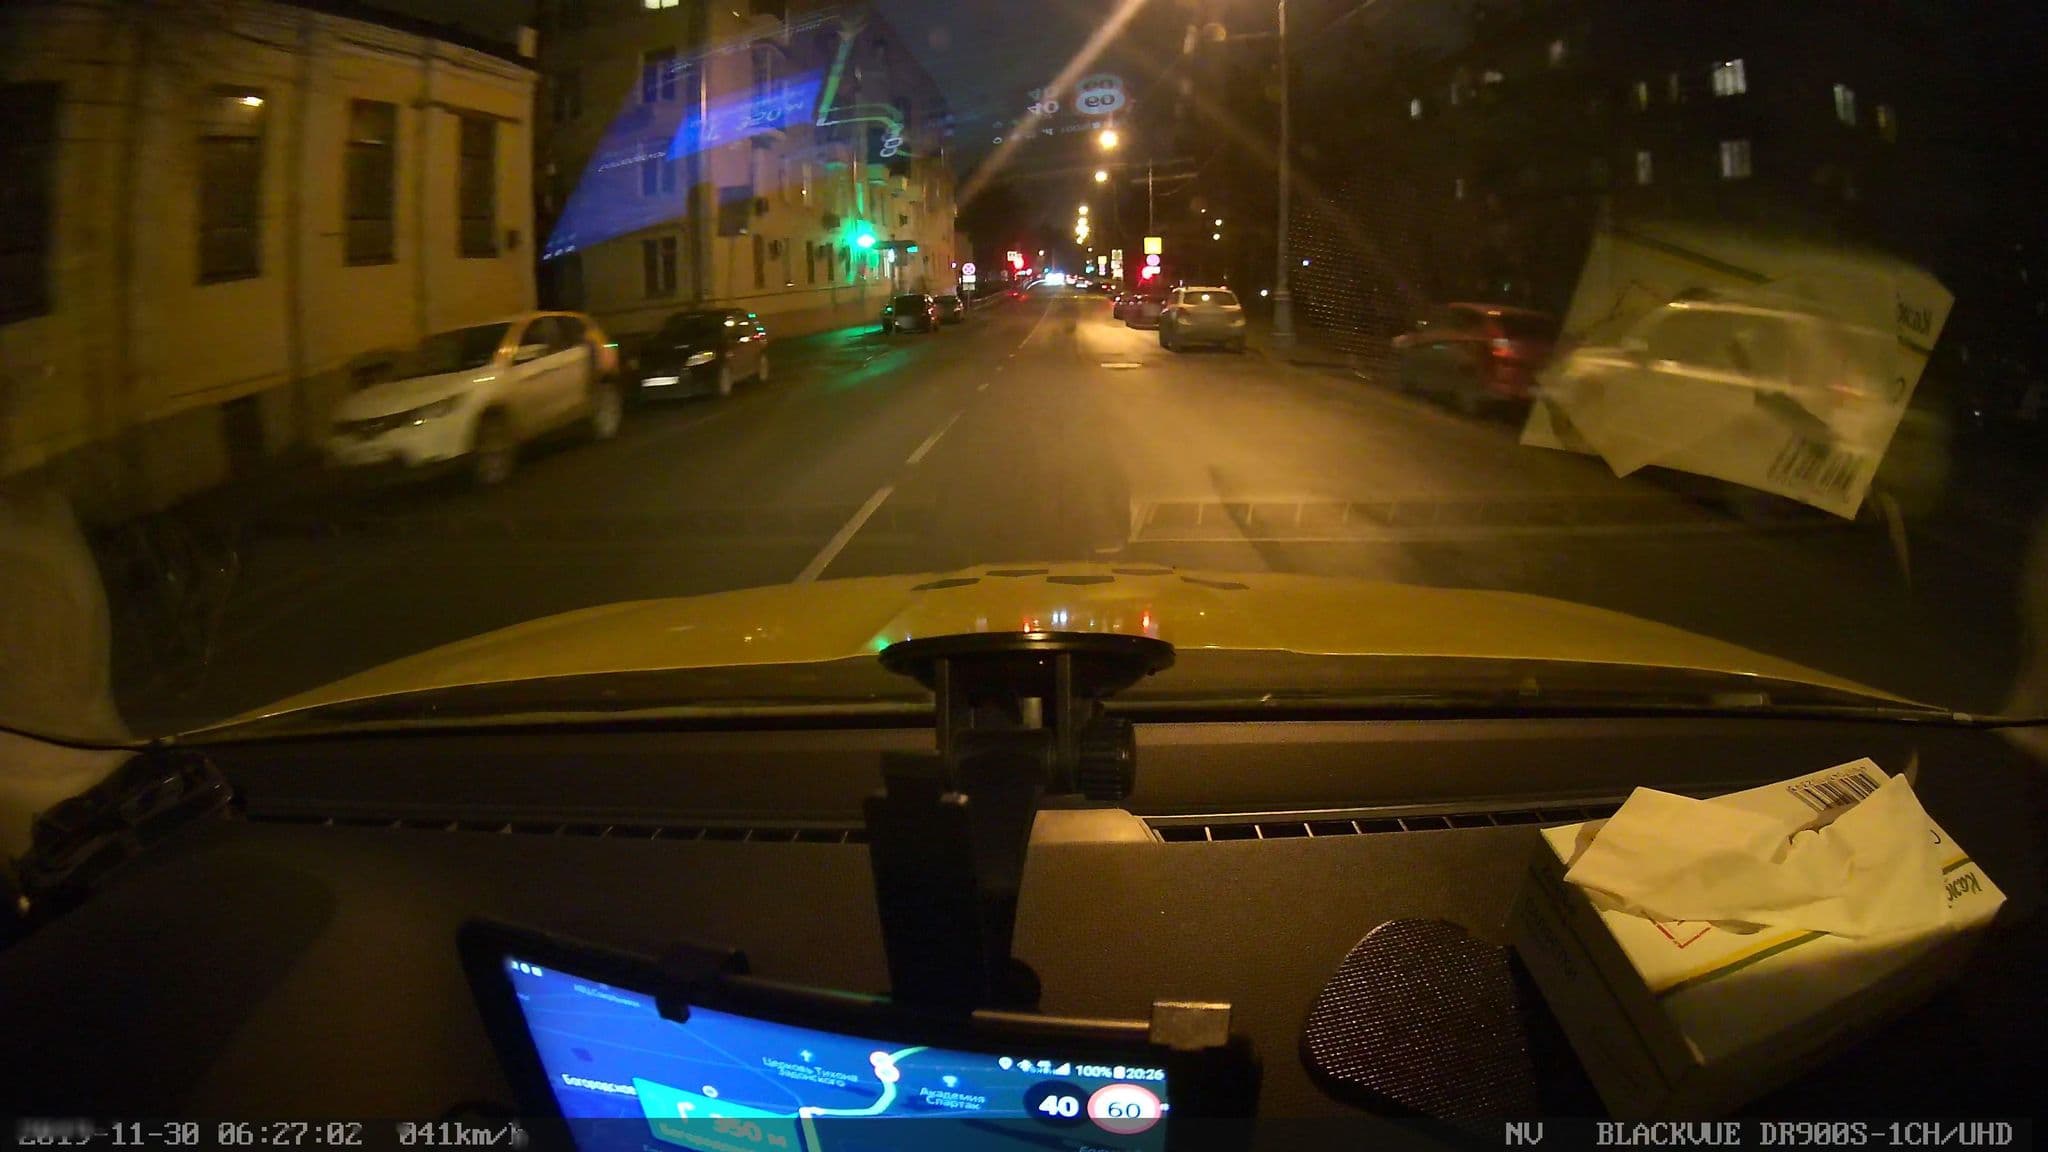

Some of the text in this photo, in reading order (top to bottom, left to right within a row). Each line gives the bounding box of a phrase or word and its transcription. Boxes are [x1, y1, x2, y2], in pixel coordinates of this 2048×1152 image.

[814, 1066, 859, 1083] Тихона
[1075, 1065, 1165, 1081] 100% 20:26
[920, 1087, 985, 1104] Академия
[926, 1096, 982, 1111] Спартак
[1038, 1095, 1080, 1117] 40
[1108, 1101, 1142, 1120] 60
